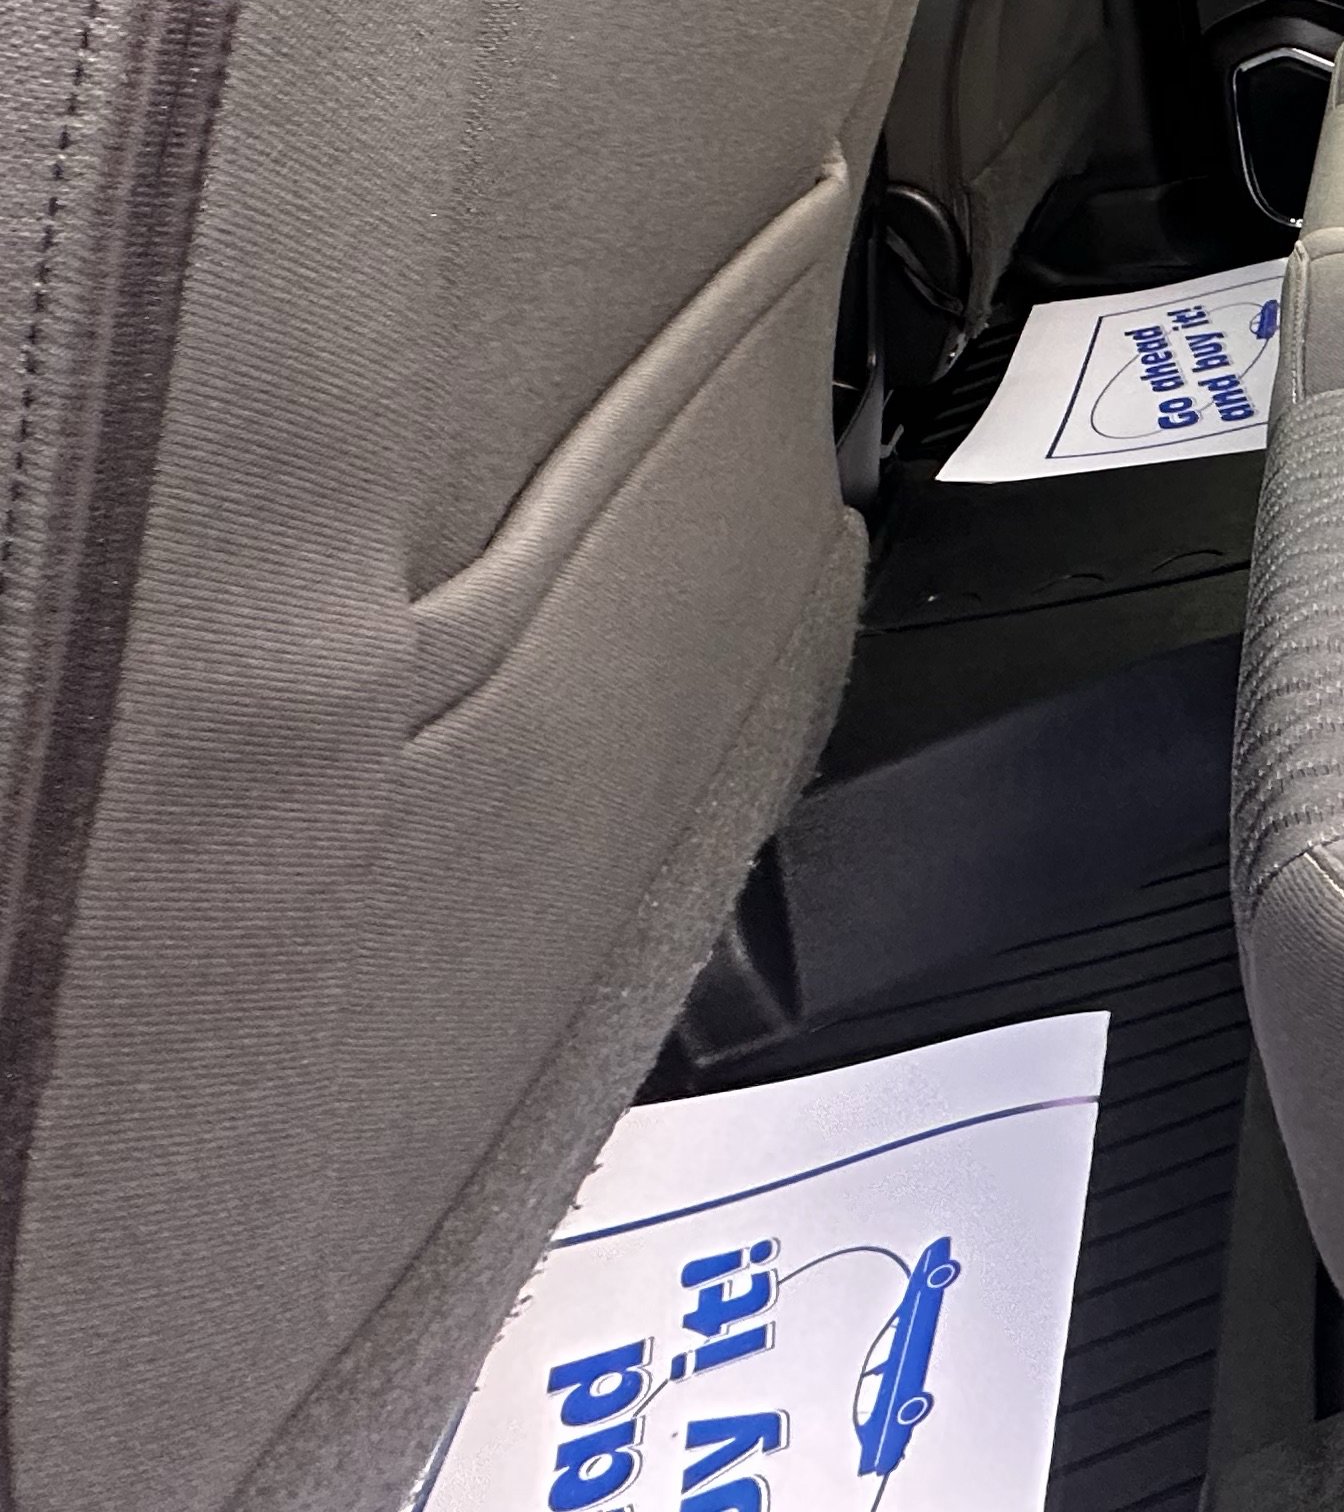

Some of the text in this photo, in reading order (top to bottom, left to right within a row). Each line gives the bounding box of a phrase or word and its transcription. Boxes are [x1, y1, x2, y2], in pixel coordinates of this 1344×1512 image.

[1123, 324, 1200, 430] Go ahead
[1166, 304, 1255, 422] and buy it!
[670, 1236, 781, 1382] it!
[546, 1337, 654, 1512] ad
